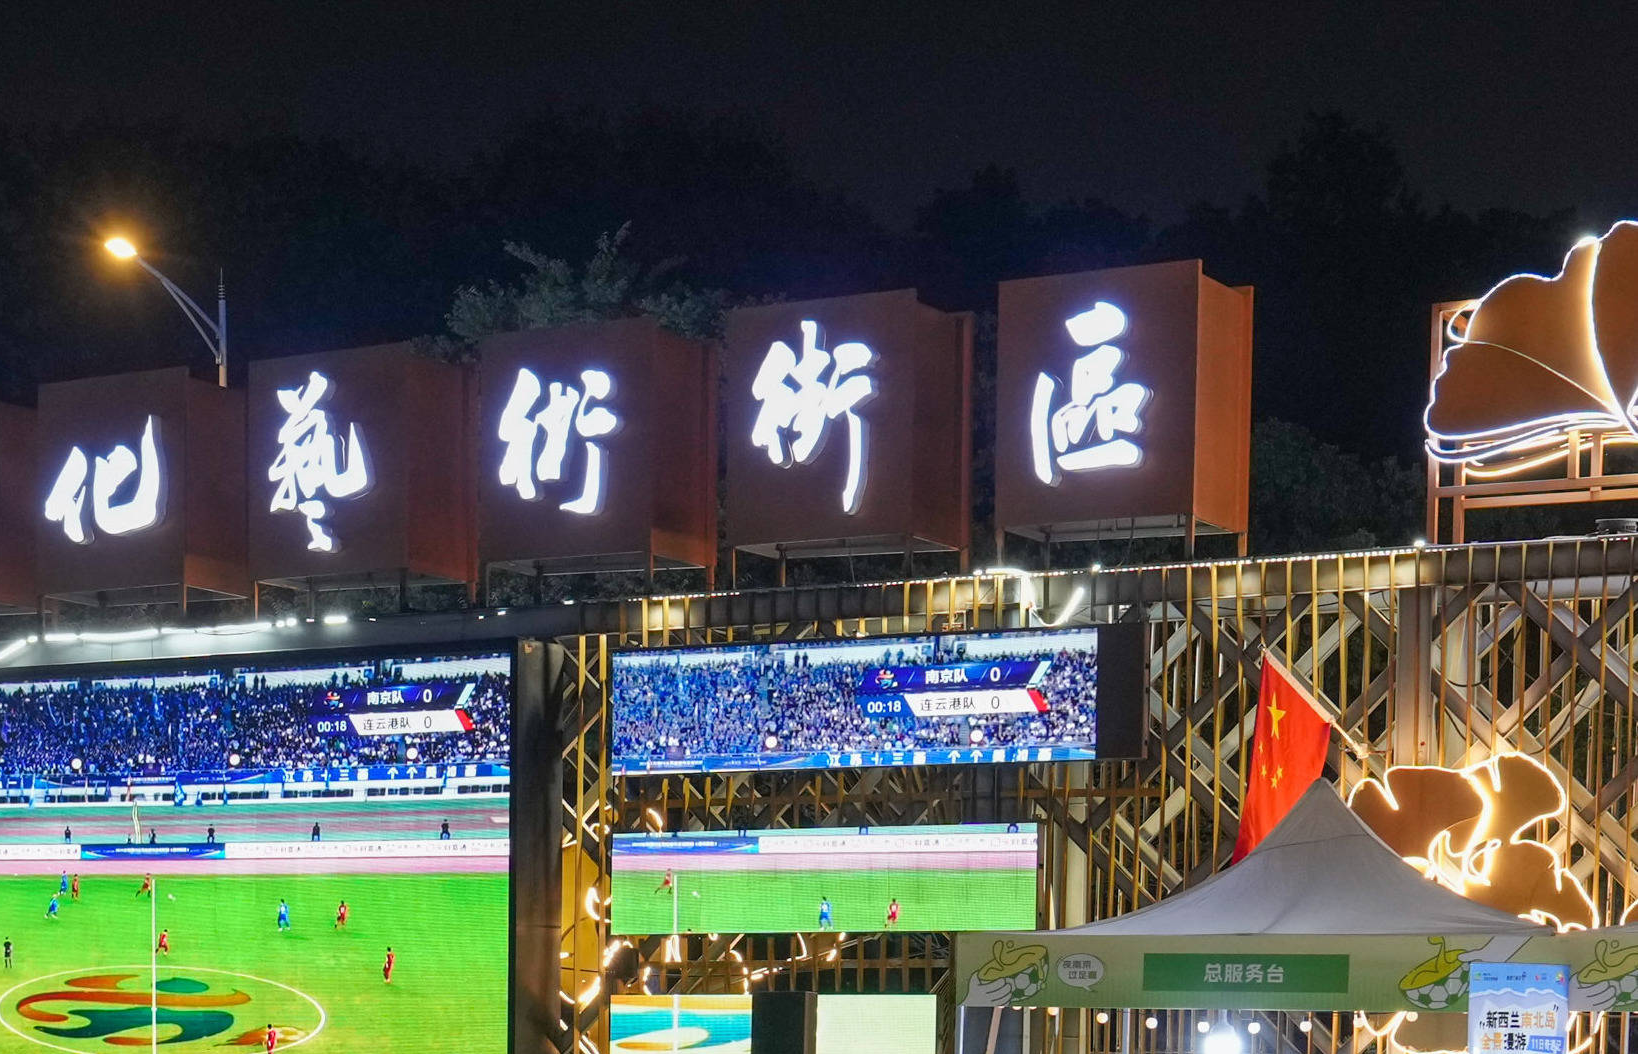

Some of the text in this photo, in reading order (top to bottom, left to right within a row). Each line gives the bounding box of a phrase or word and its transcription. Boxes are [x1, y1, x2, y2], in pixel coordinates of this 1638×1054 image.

[925, 667, 1001, 684] 南京队 0
[367, 689, 432, 705] 南京队 0
[920, 696, 976, 711] 连云港队
[867, 701, 901, 713] 00:18
[317, 721, 347, 732] 00:18
[363, 716, 411, 730] 连云港队
[1203, 963, 1284, 982] 总服务台
